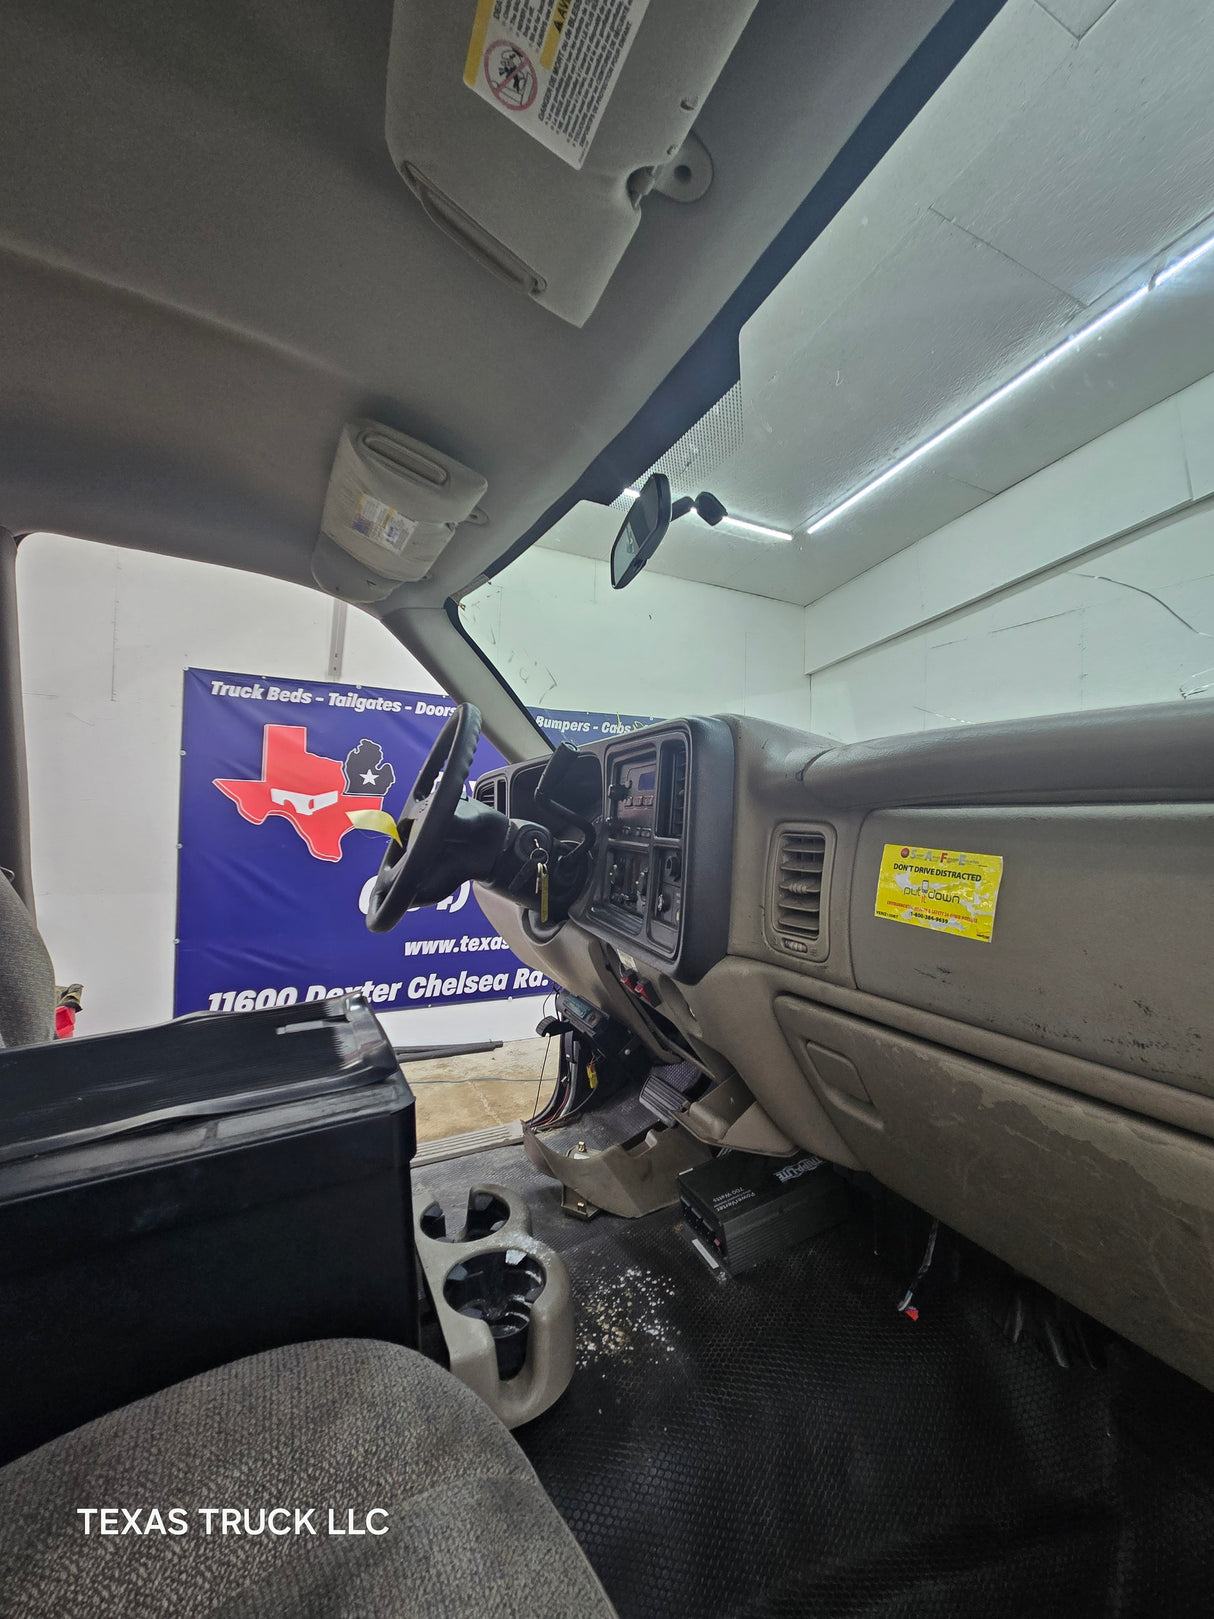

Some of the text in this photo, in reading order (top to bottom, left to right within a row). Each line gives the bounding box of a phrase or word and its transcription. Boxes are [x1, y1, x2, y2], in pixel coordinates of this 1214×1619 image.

[211, 680, 264, 699] Truck
[266, 686, 313, 704] Beds
[328, 692, 402, 712] Tailgates
[535, 715, 591, 733] Bumpers
[601, 721, 632, 734] Cabs
[893, 863, 982, 882] DON'T DRIVE DISTRACTED
[208, 986, 298, 1012] 11600
[407, 970, 509, 999] Chelsea
